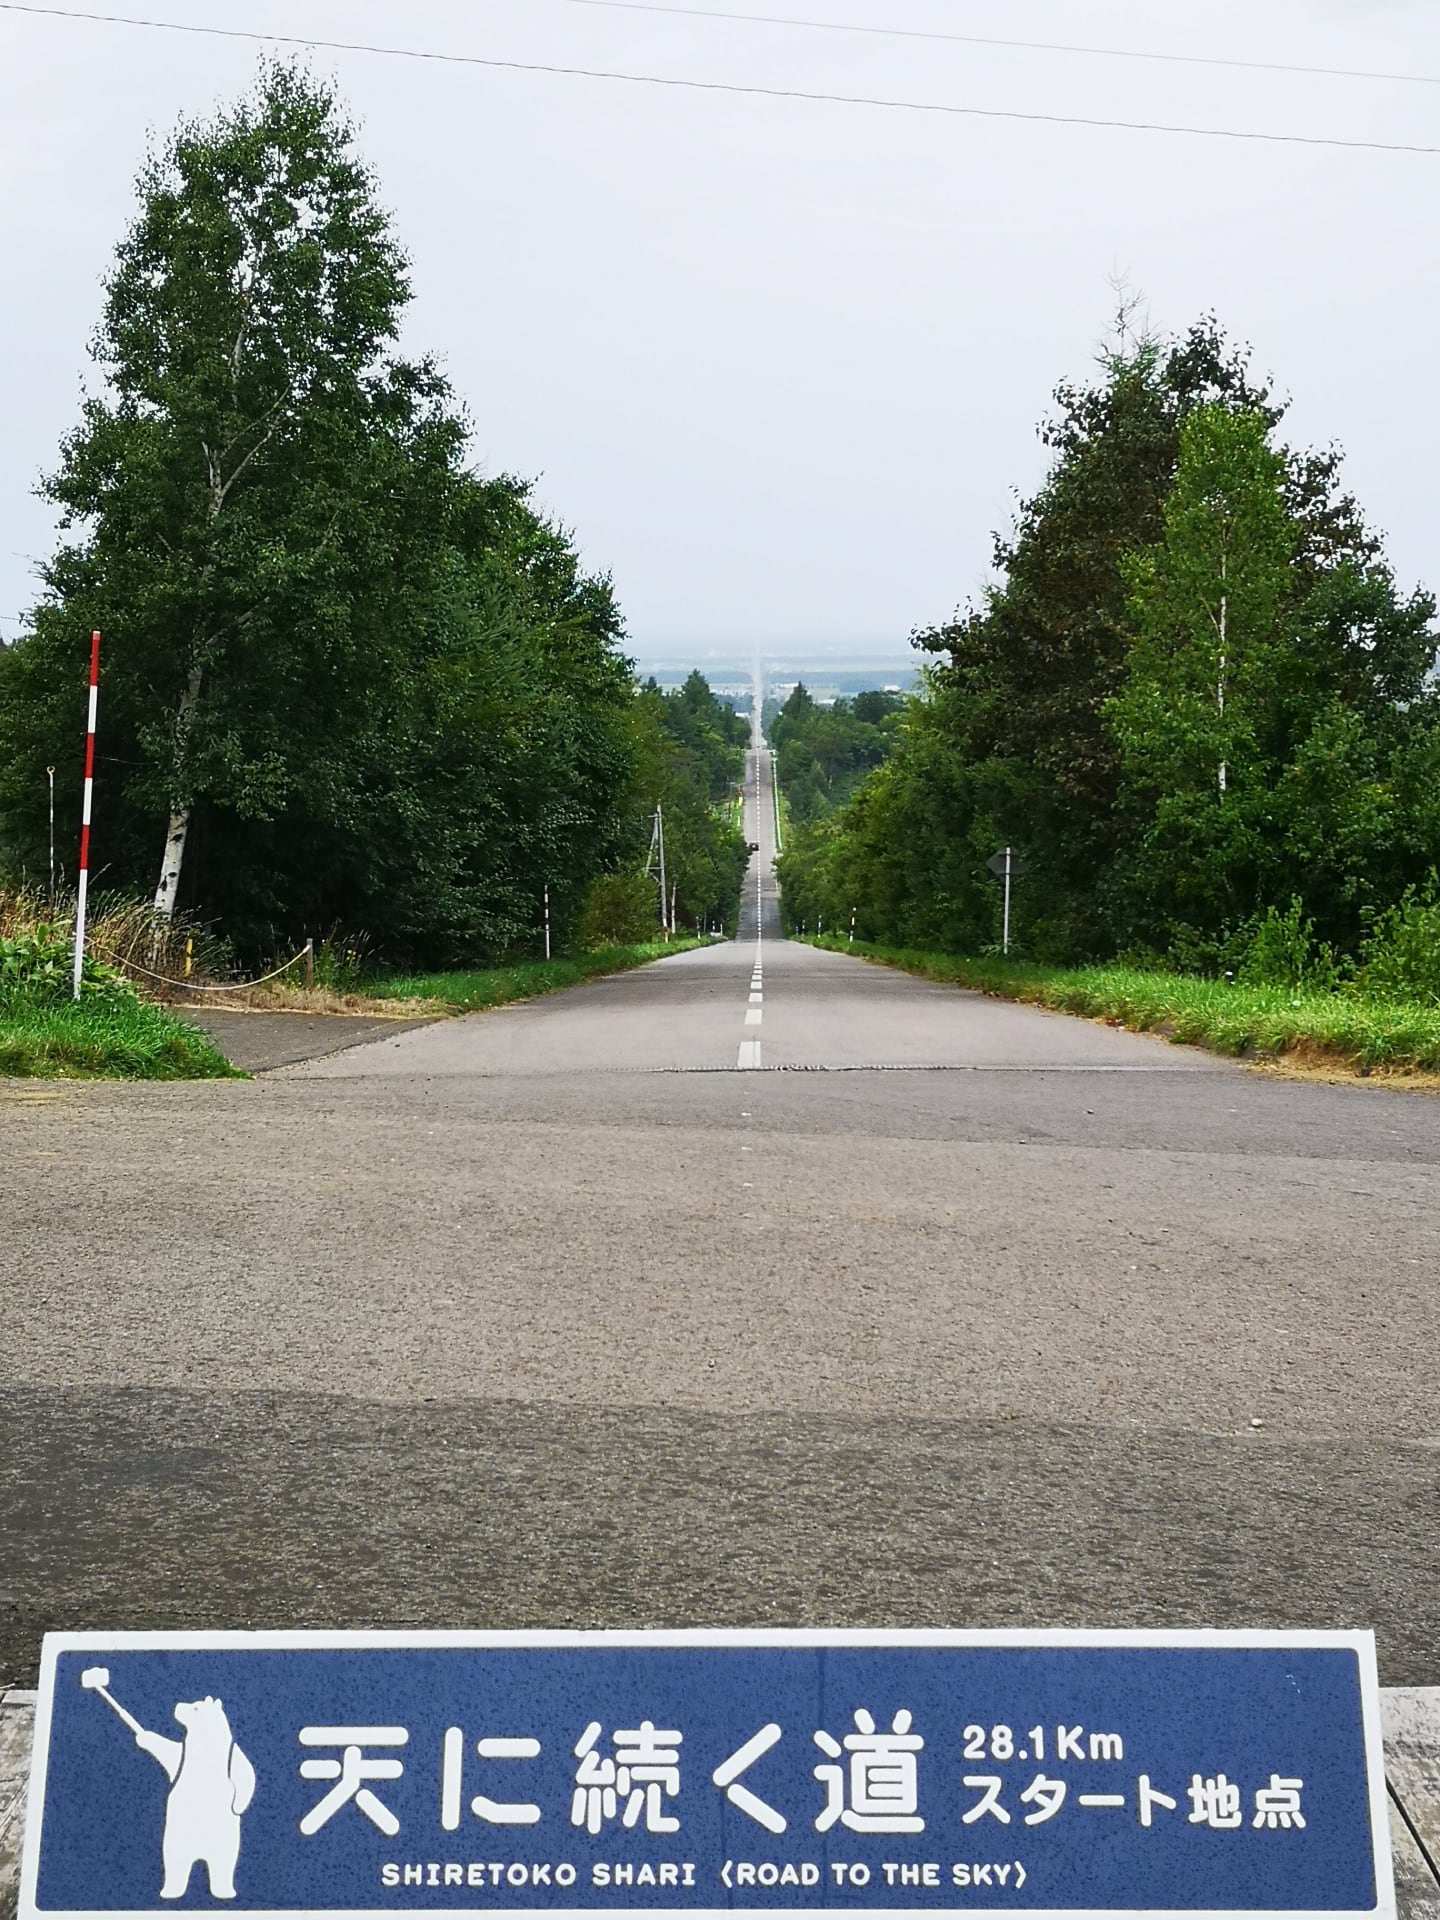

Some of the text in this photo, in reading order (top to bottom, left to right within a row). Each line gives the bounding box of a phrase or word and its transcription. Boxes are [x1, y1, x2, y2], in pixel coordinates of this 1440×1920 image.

[297, 1707, 926, 1837] 天に続く道
[961, 1772, 1307, 1829] スタート地点
[381, 1862, 577, 1887] SHIRETOKO
[592, 1862, 696, 1887] SHARI
[831, 1862, 871, 1887] TO
[882, 1862, 941, 1887] THE
